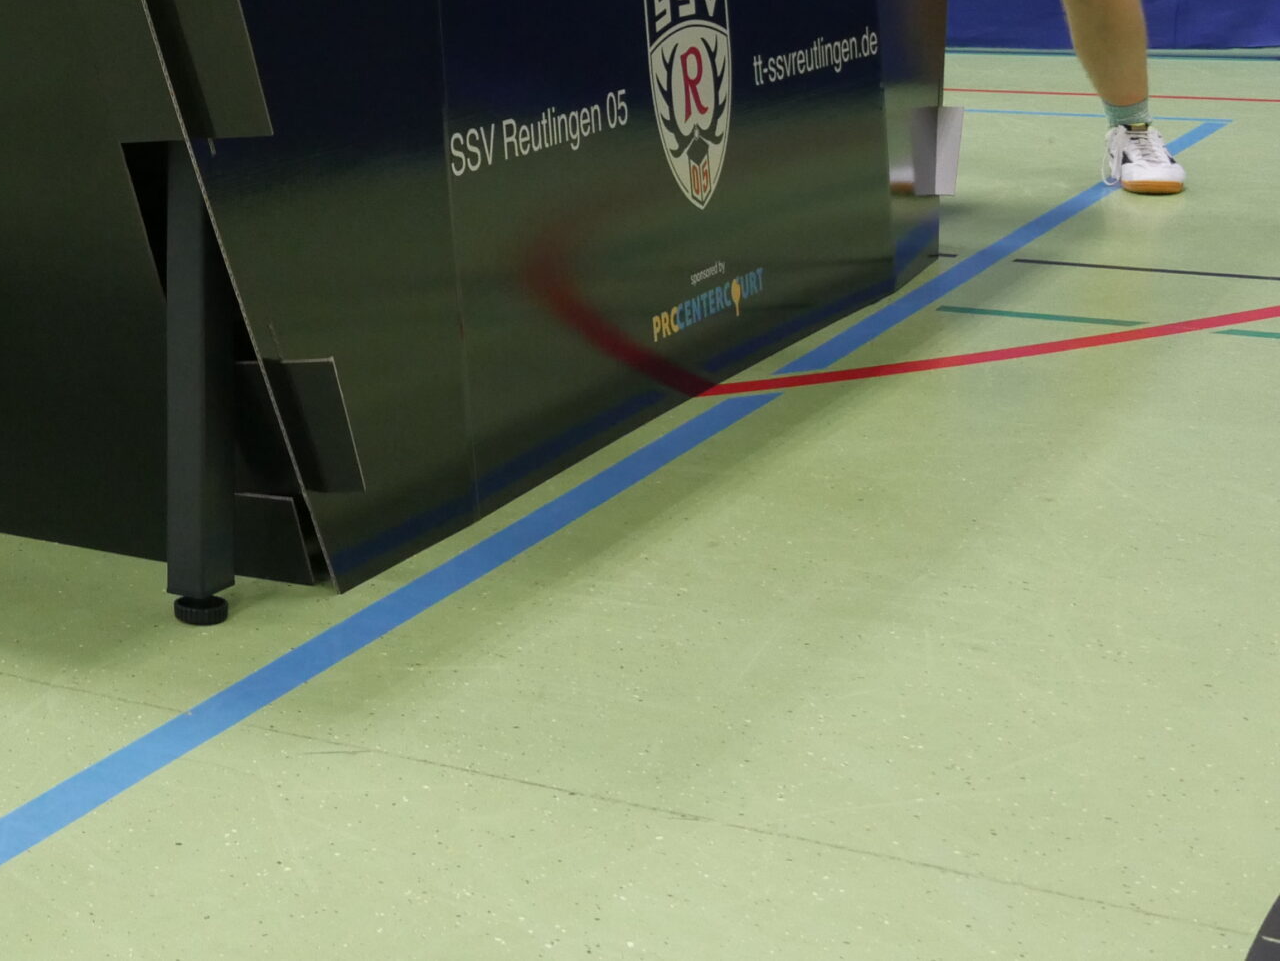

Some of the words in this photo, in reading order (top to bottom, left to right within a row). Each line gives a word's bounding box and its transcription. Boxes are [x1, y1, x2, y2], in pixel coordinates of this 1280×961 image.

[680, 46, 709, 124] R
[753, 26, 878, 86] tt-ssvreutlingen.de
[450, 124, 495, 177] SSV
[503, 100, 603, 161] Reutlingen
[606, 89, 629, 129] 05
[690, 263, 718, 286] sponsored
[718, 260, 726, 275] by
